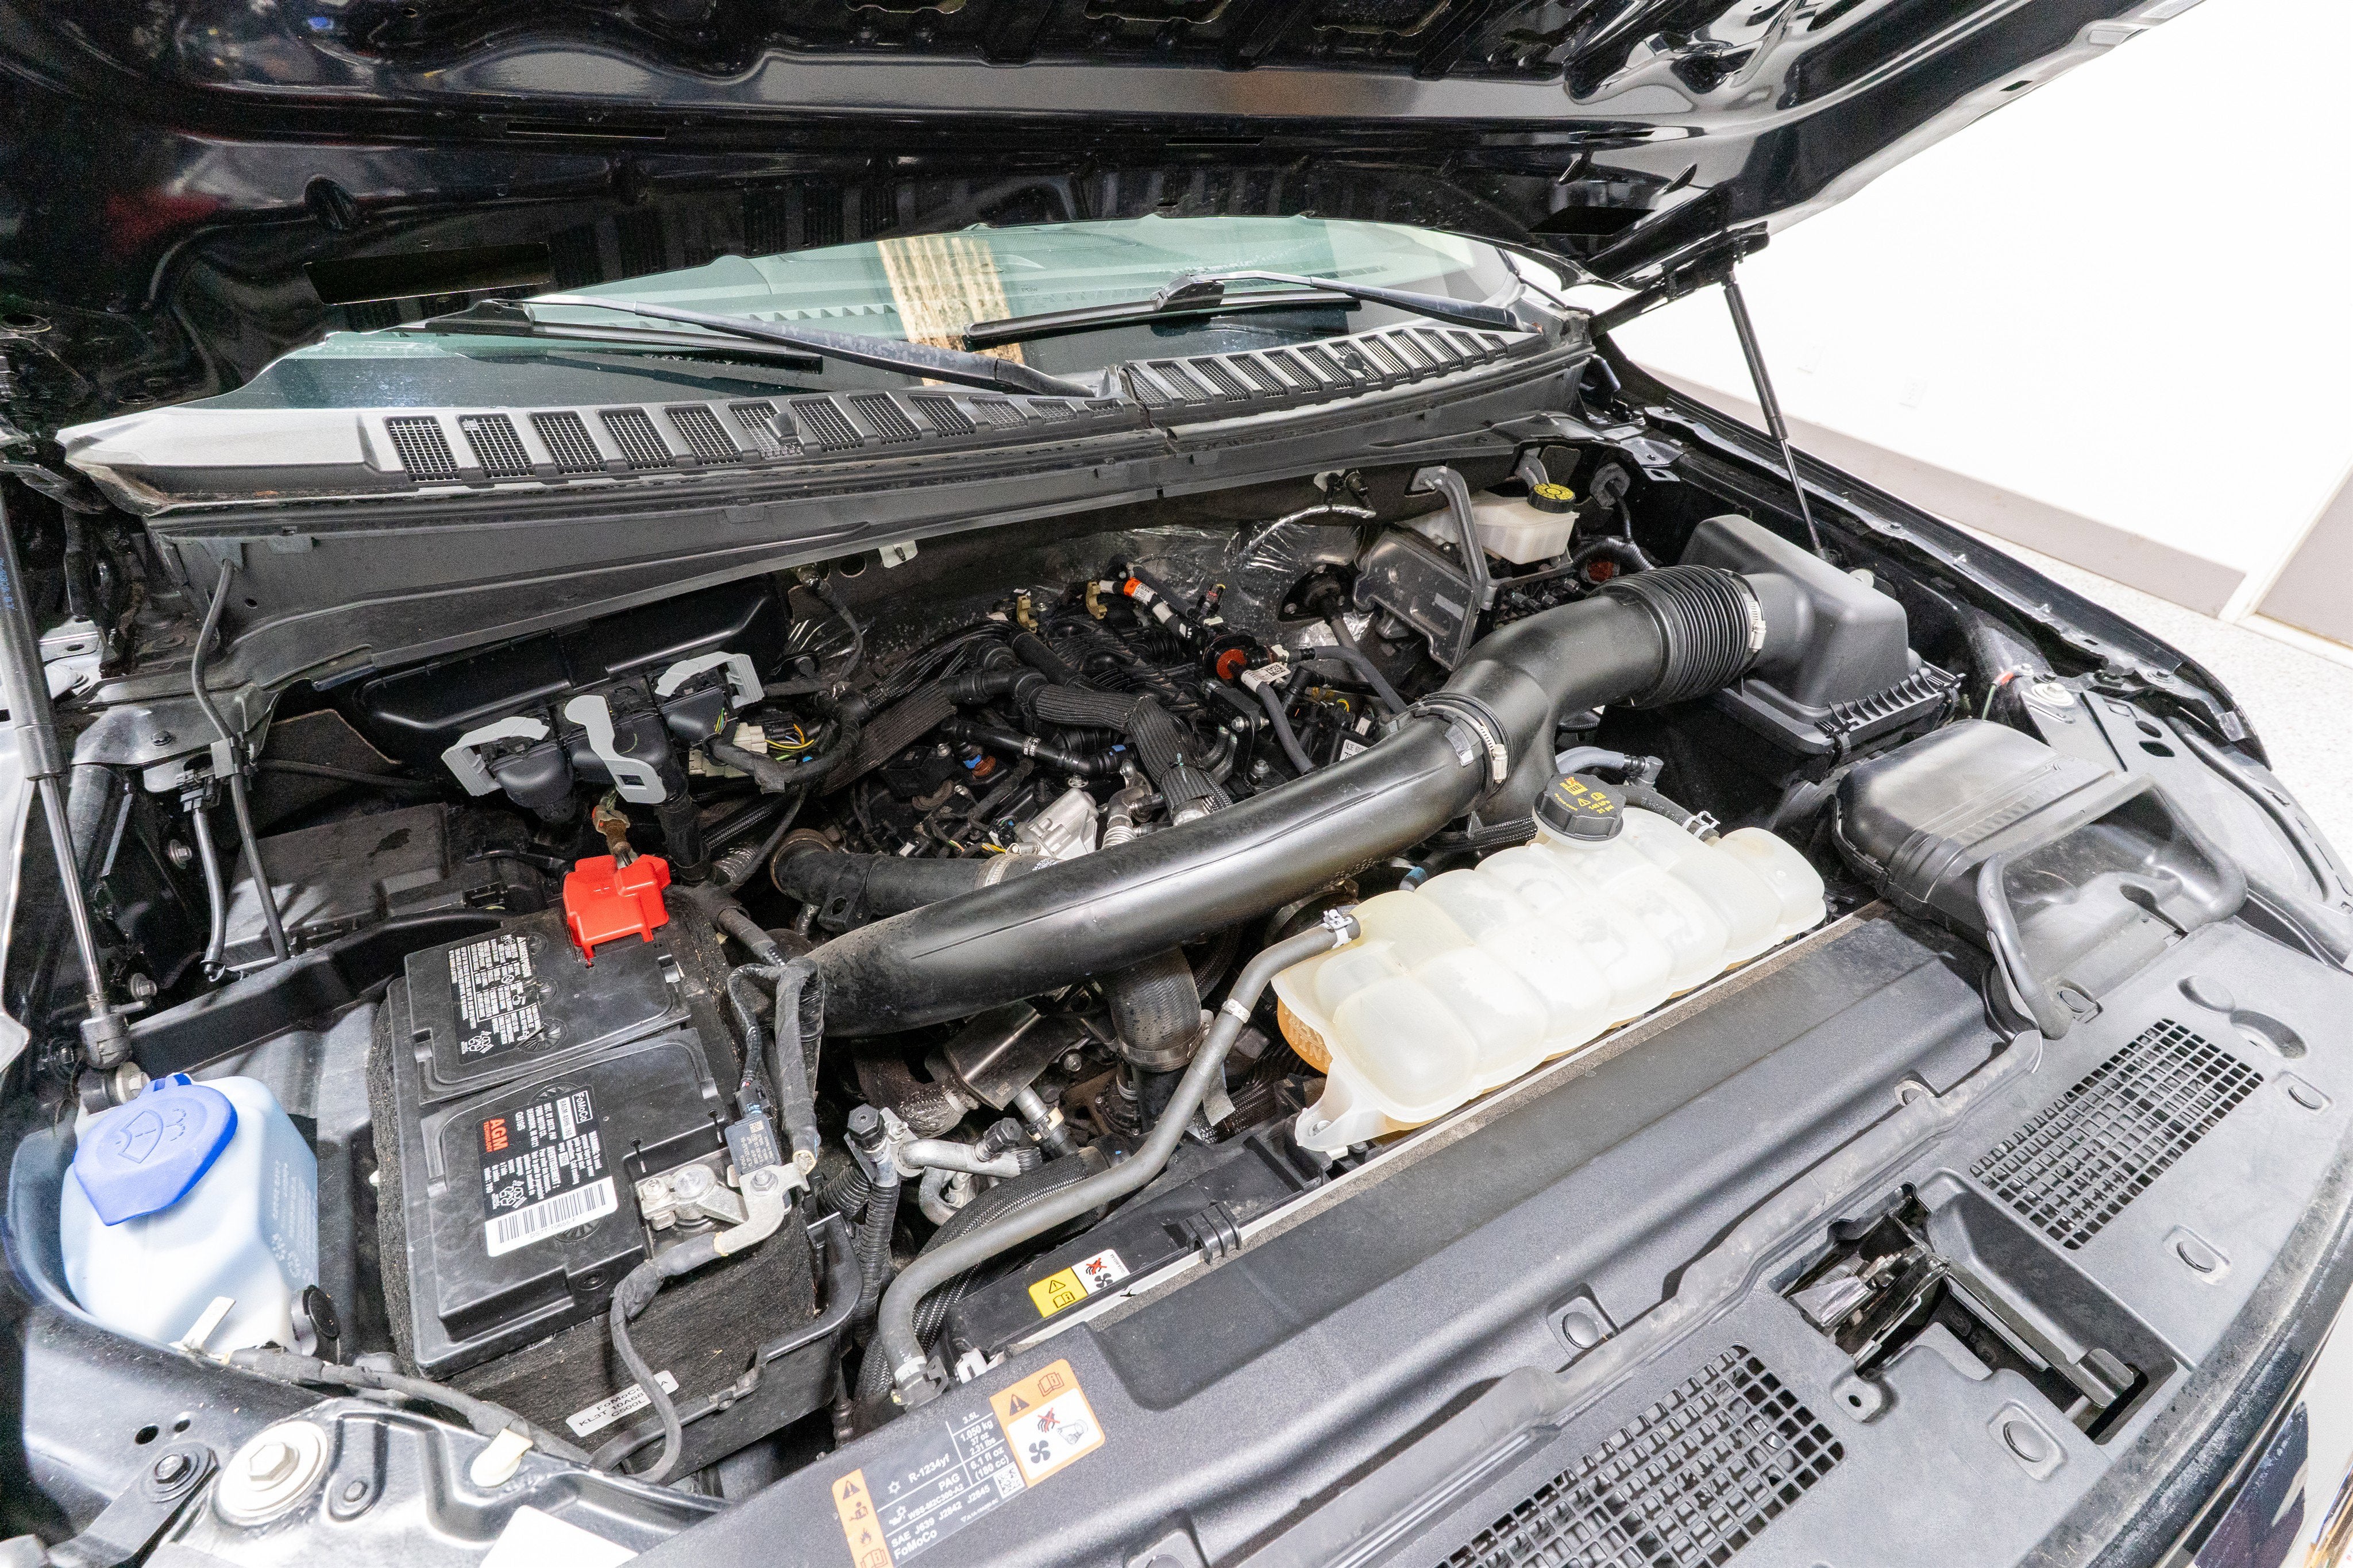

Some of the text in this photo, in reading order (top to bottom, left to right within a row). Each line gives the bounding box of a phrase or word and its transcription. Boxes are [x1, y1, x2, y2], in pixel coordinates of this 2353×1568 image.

[576, 1093, 588, 1121] FoMoCo
[484, 1121, 492, 1152] TECHNOLOGY
[490, 1119, 507, 1150] AGM
[578, 1410, 608, 1427] KL3T
[611, 1399, 646, 1418] C500L
[962, 1412, 979, 1423] 3.5L
[960, 1420, 993, 1441] 1.050 kg
[970, 1432, 989, 1445] 37 oz
[970, 1437, 996, 1455] 2.31 lbs
[970, 1446, 1004, 1469] 6.1 fl oz
[908, 1454, 949, 1482] R-1234yf
[975, 1454, 1009, 1480] (180 cc)
[938, 1473, 959, 1490] PAG
[908, 1484, 965, 1519] WSS-M2C300-A2
[891, 1531, 911, 1547] SAE
[915, 1517, 934, 1534] J639
[939, 1501, 962, 1520] J2842
[967, 1485, 990, 1503] J2845
[894, 1530, 936, 1559] FoMoCo
